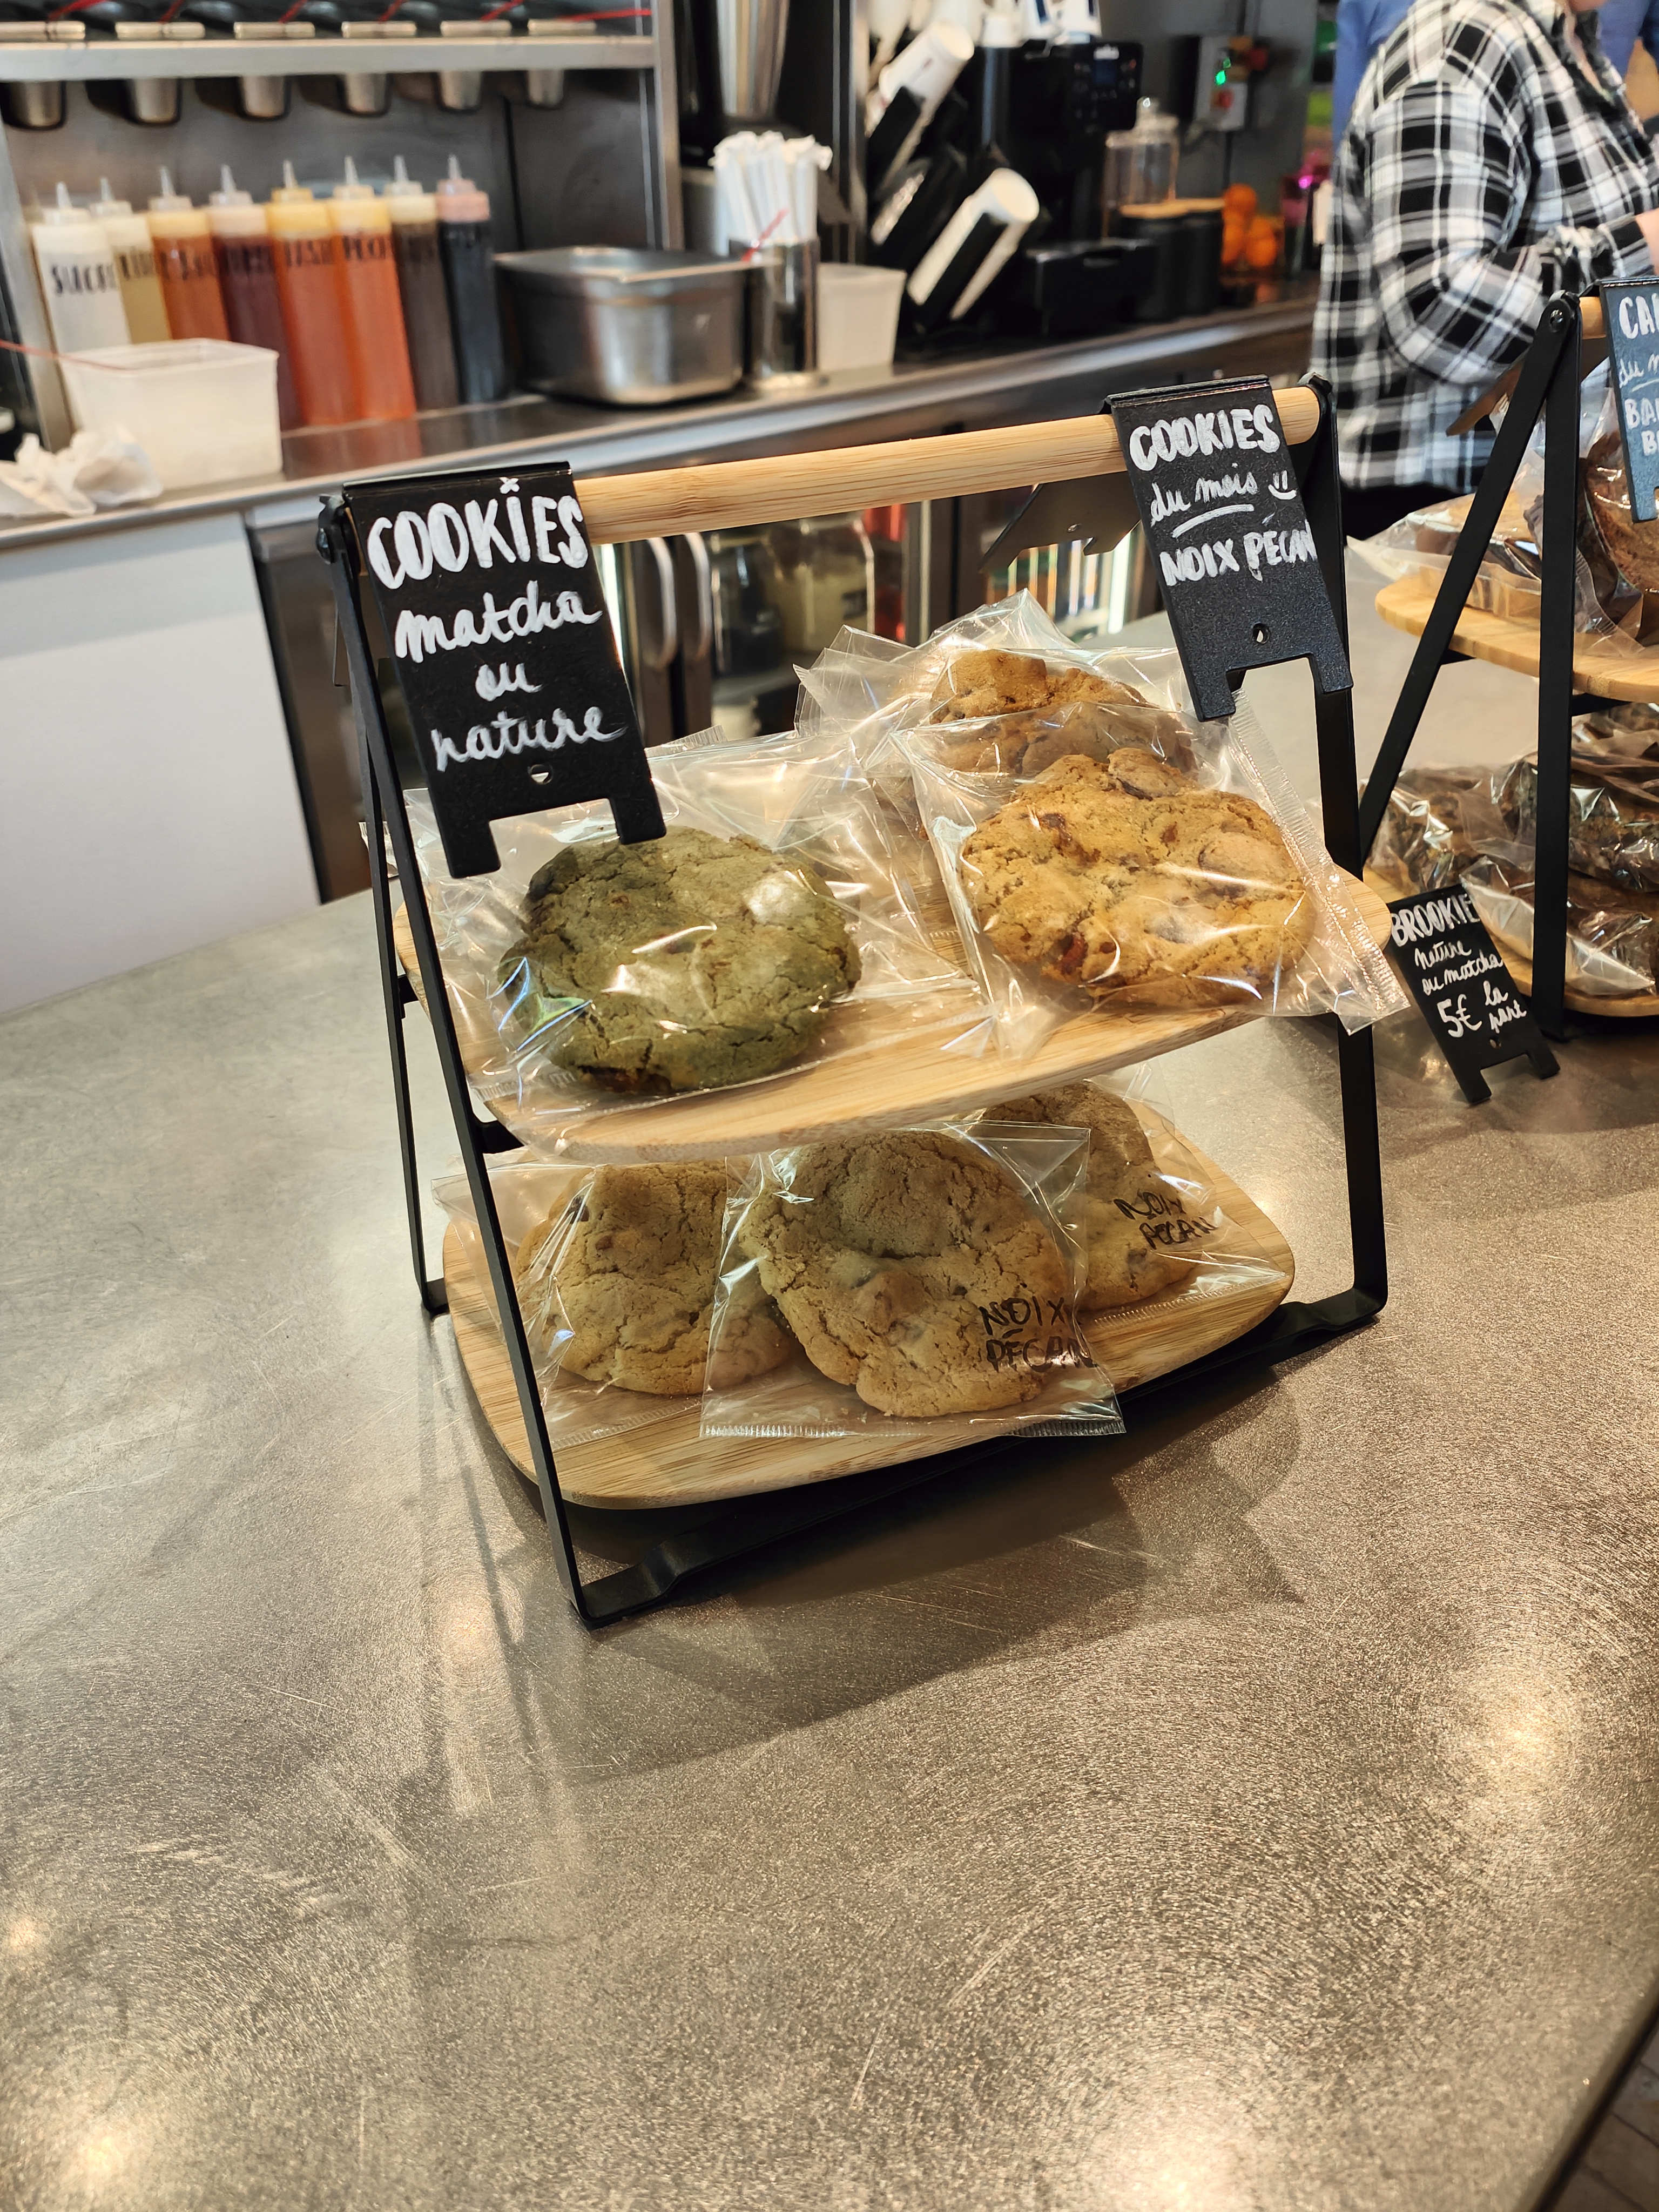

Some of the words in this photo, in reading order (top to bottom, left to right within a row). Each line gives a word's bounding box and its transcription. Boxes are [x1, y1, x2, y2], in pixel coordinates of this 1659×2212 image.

[1129, 404, 1280, 471] COOKIES
[1641, 430, 1659, 456] B
[1150, 482, 1191, 527] du
[1195, 462, 1258, 502] mois
[368, 477, 588, 589] COOKIES
[1159, 538, 1240, 586] NOIX
[395, 581, 603, 663] matcha
[476, 662, 542, 701] ou
[431, 707, 628, 772] nature
[1391, 894, 1480, 947] BROOKIE
[1422, 976, 1444, 996] ou
[1444, 949, 1503, 984] matcha
[1437, 994, 1482, 1037] 5€
[1483, 981, 1508, 1006] la
[1489, 1000, 1527, 1034] part
[1113, 1189, 1186, 1220] NOIX
[979, 1296, 1065, 1335] NOIX
